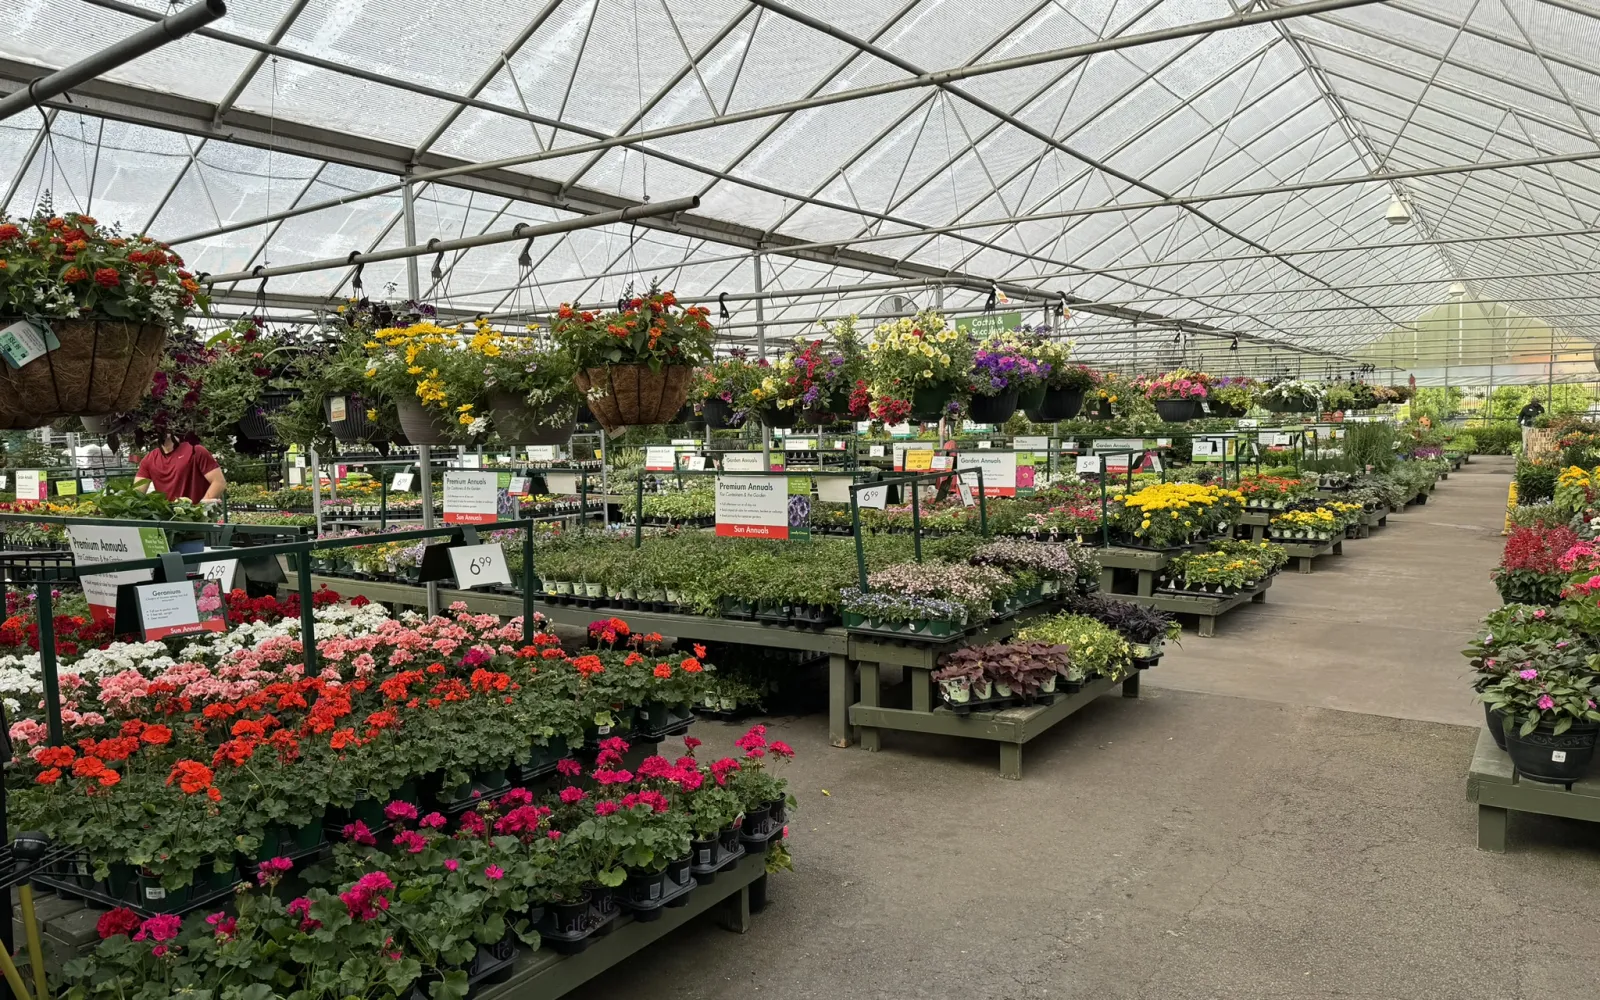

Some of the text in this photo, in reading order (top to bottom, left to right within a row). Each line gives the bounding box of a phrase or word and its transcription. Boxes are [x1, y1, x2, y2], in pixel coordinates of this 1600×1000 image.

[971, 316, 1004, 327] Cactus &
[719, 482, 774, 491] Premium Annuals
[734, 525, 769, 534] Sun Annuals
[72, 536, 99, 550] Premium
[100, 538, 128, 552] Annuals
[182, 624, 202, 633] Annual
